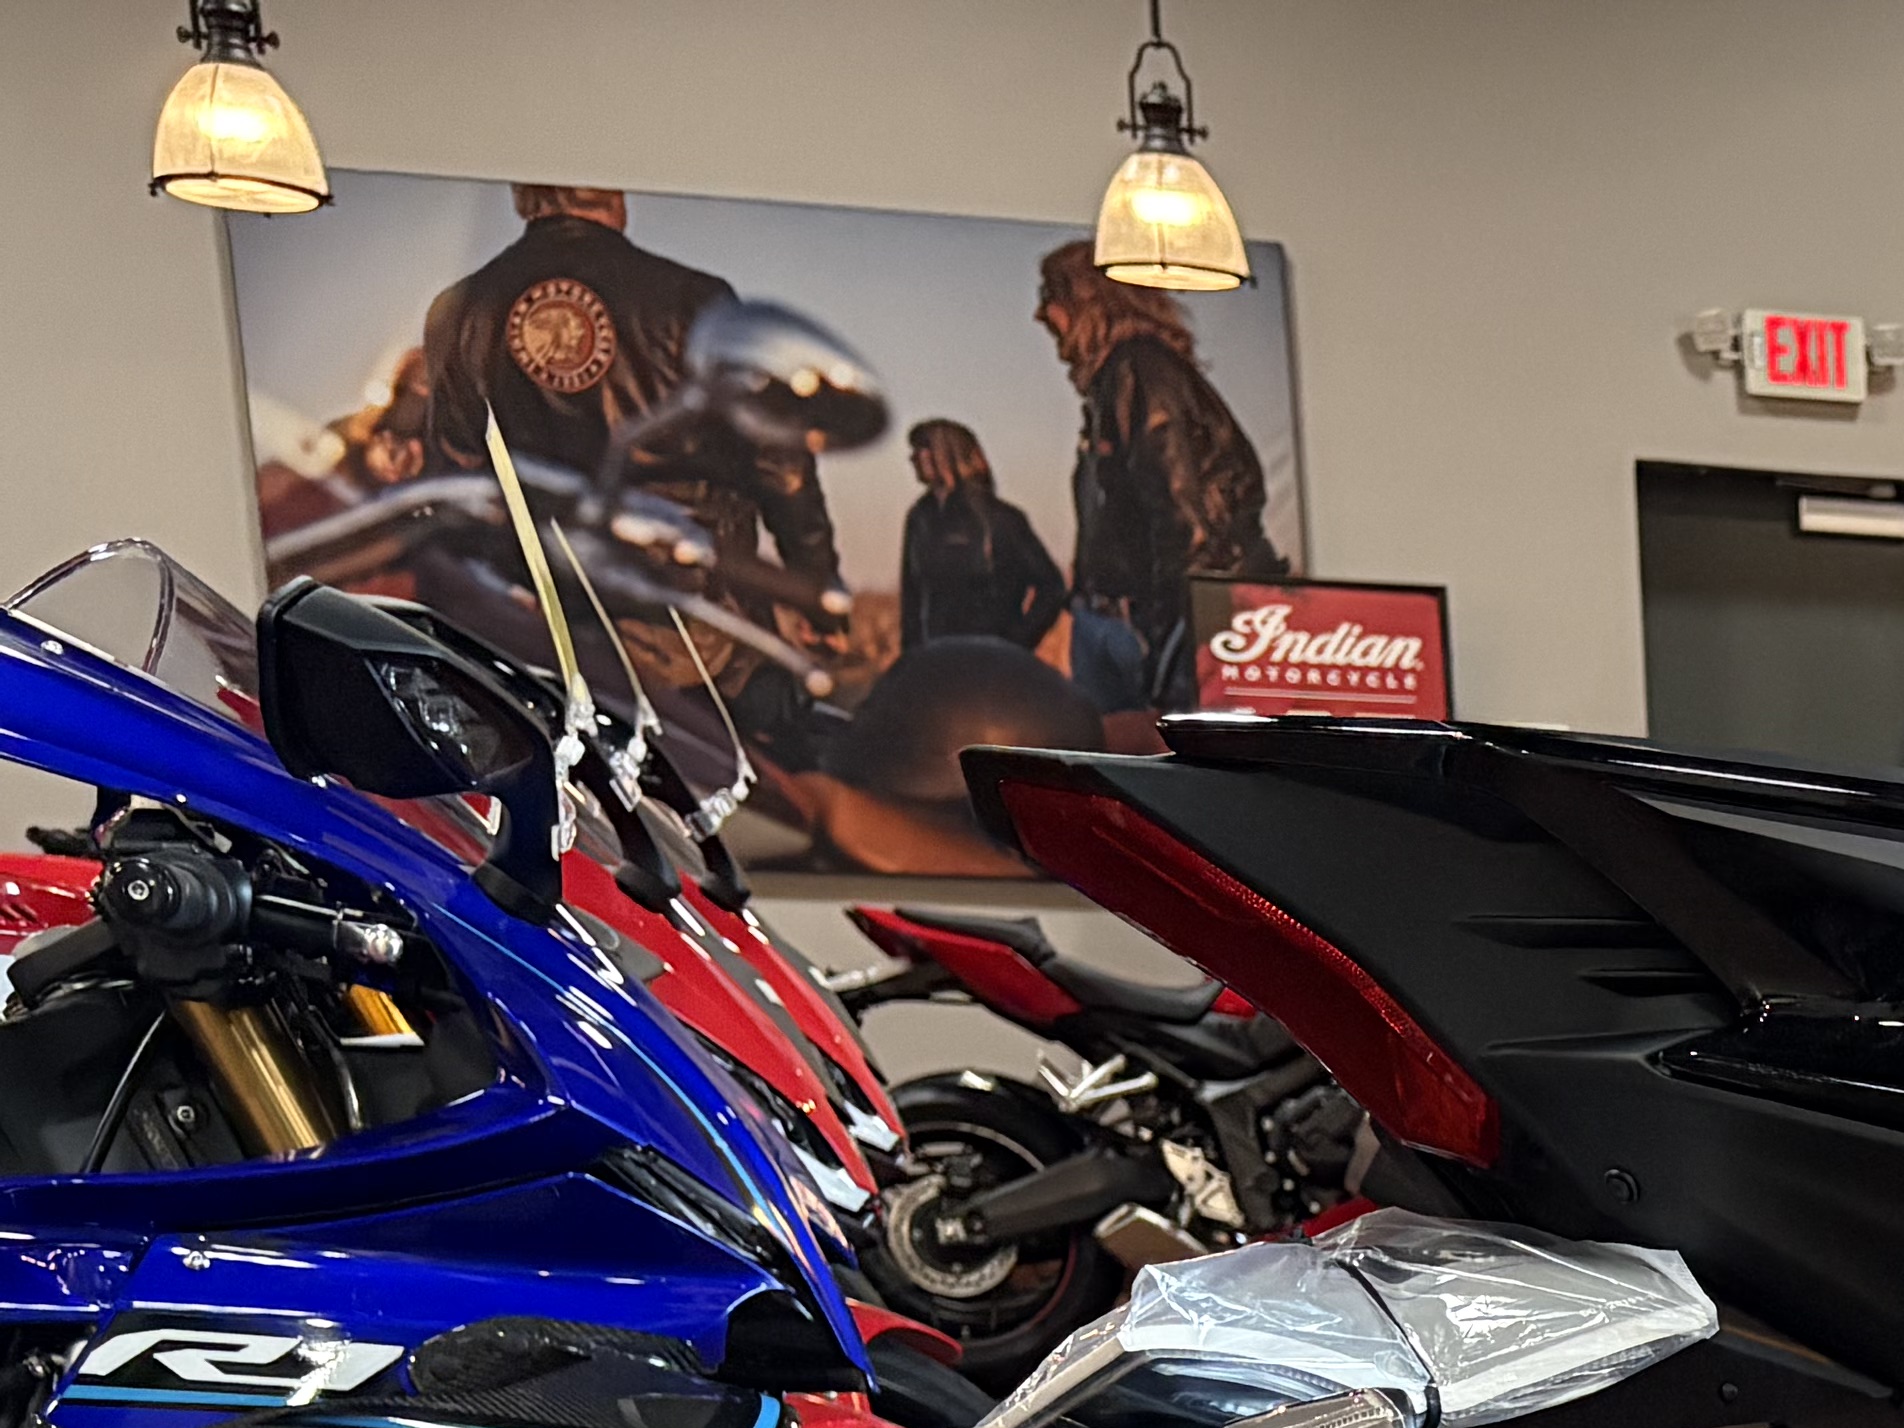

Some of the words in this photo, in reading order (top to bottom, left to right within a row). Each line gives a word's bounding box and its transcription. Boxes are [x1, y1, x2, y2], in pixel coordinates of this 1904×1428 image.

[1764, 315, 1850, 390] EXIT
[1210, 604, 1424, 671] Indian
[1221, 665, 1418, 690] MOTORCYCLE
[78, 1328, 404, 1398] R1
